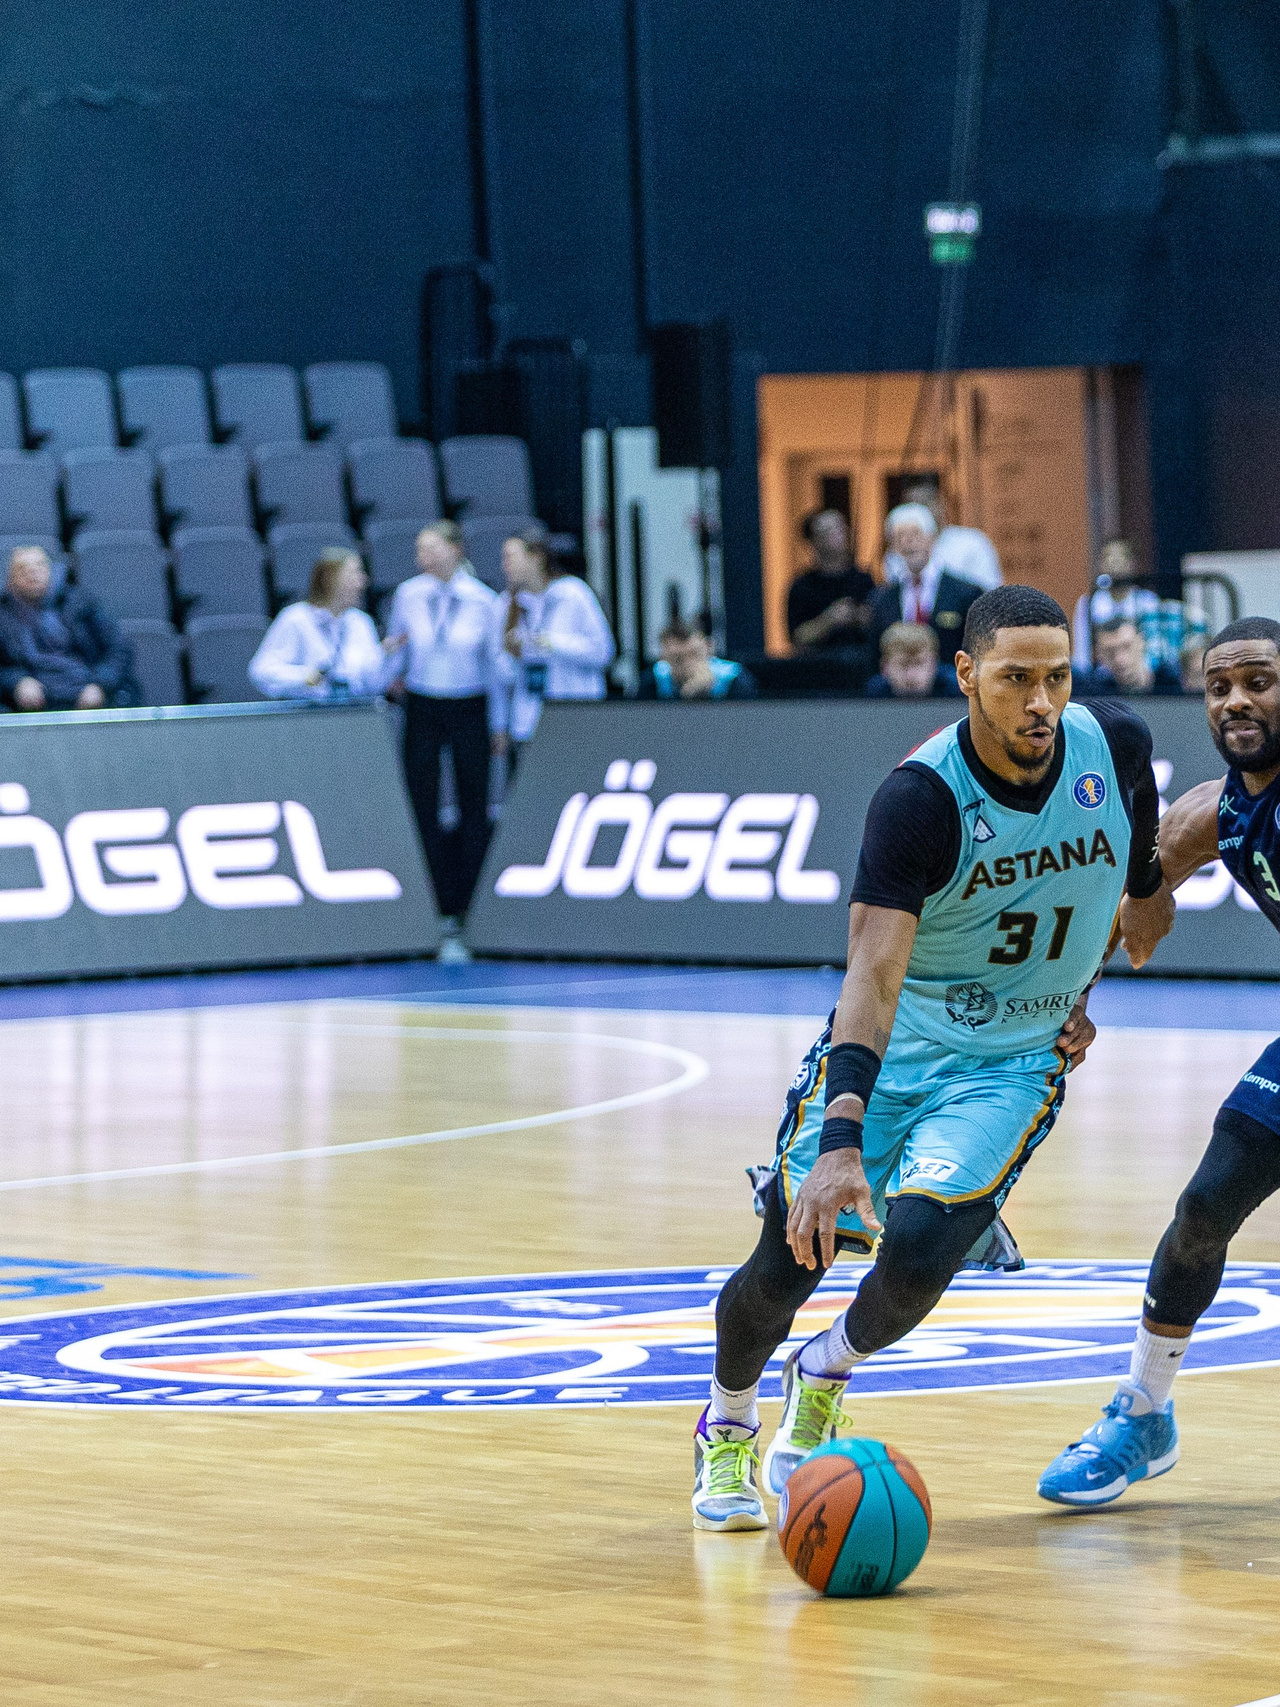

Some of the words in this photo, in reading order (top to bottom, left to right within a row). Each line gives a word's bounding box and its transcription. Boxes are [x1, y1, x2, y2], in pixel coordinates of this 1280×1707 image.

[494, 758, 841, 903] JÖGEL
[961, 828, 1117, 901] ASTANA
[1253, 851, 1280, 901] 3
[987, 905, 1075, 965] 31
[107, 1386, 630, 1402] LEAGUE
